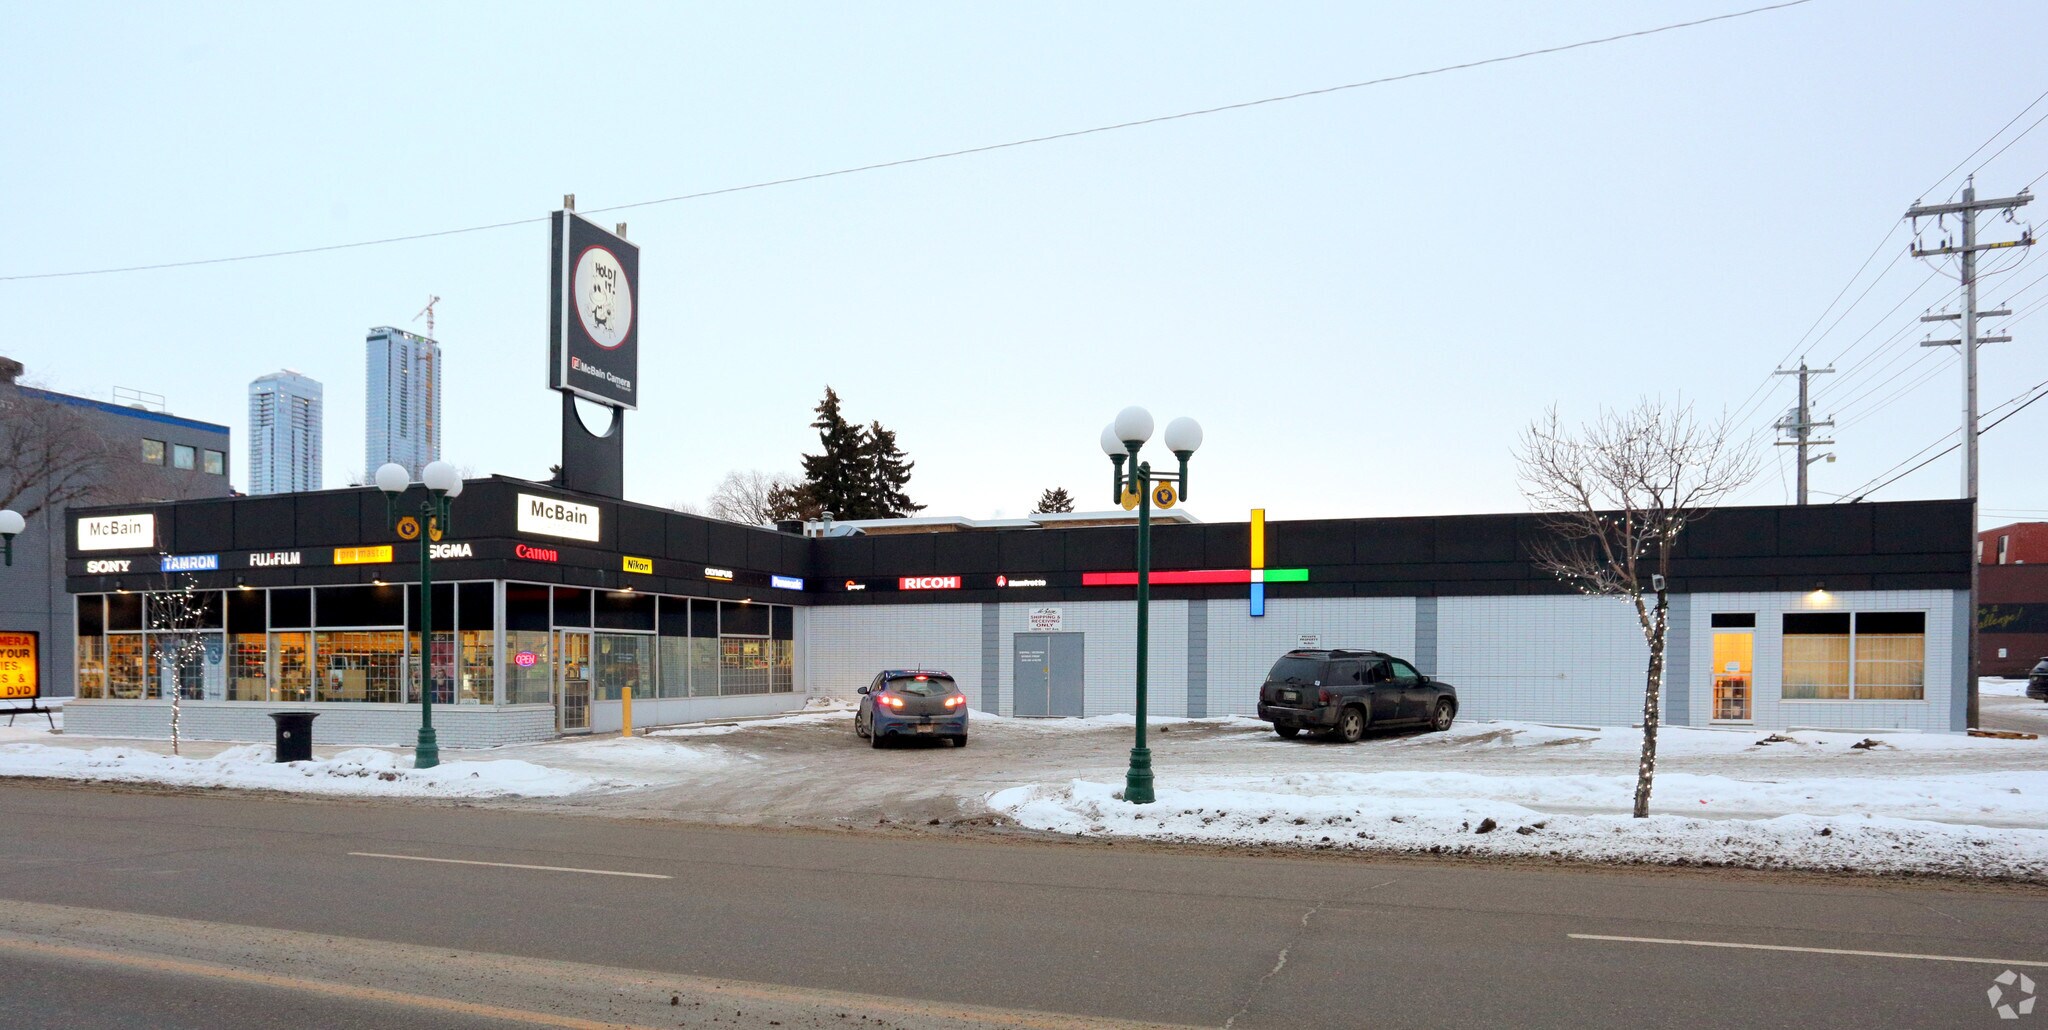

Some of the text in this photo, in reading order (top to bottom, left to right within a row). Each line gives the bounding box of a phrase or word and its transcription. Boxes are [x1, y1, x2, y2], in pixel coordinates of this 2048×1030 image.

[581, 362, 605, 379] McBain
[607, 372, 630, 388] Camera
[531, 500, 588, 525] McBain
[90, 519, 142, 536] McBain
[429, 543, 473, 559] SIGMA
[515, 544, 559, 562] Canon
[87, 560, 131, 574] SONY
[163, 556, 216, 570] TAMRON
[627, 560, 649, 571] Nikon
[904, 577, 955, 589] RICOH
[1978, 607, 2024, 629] allenge!
[0, 649, 30, 658] YOUR
[515, 654, 535, 665] OPEN
[7, 685, 32, 696] DVD
